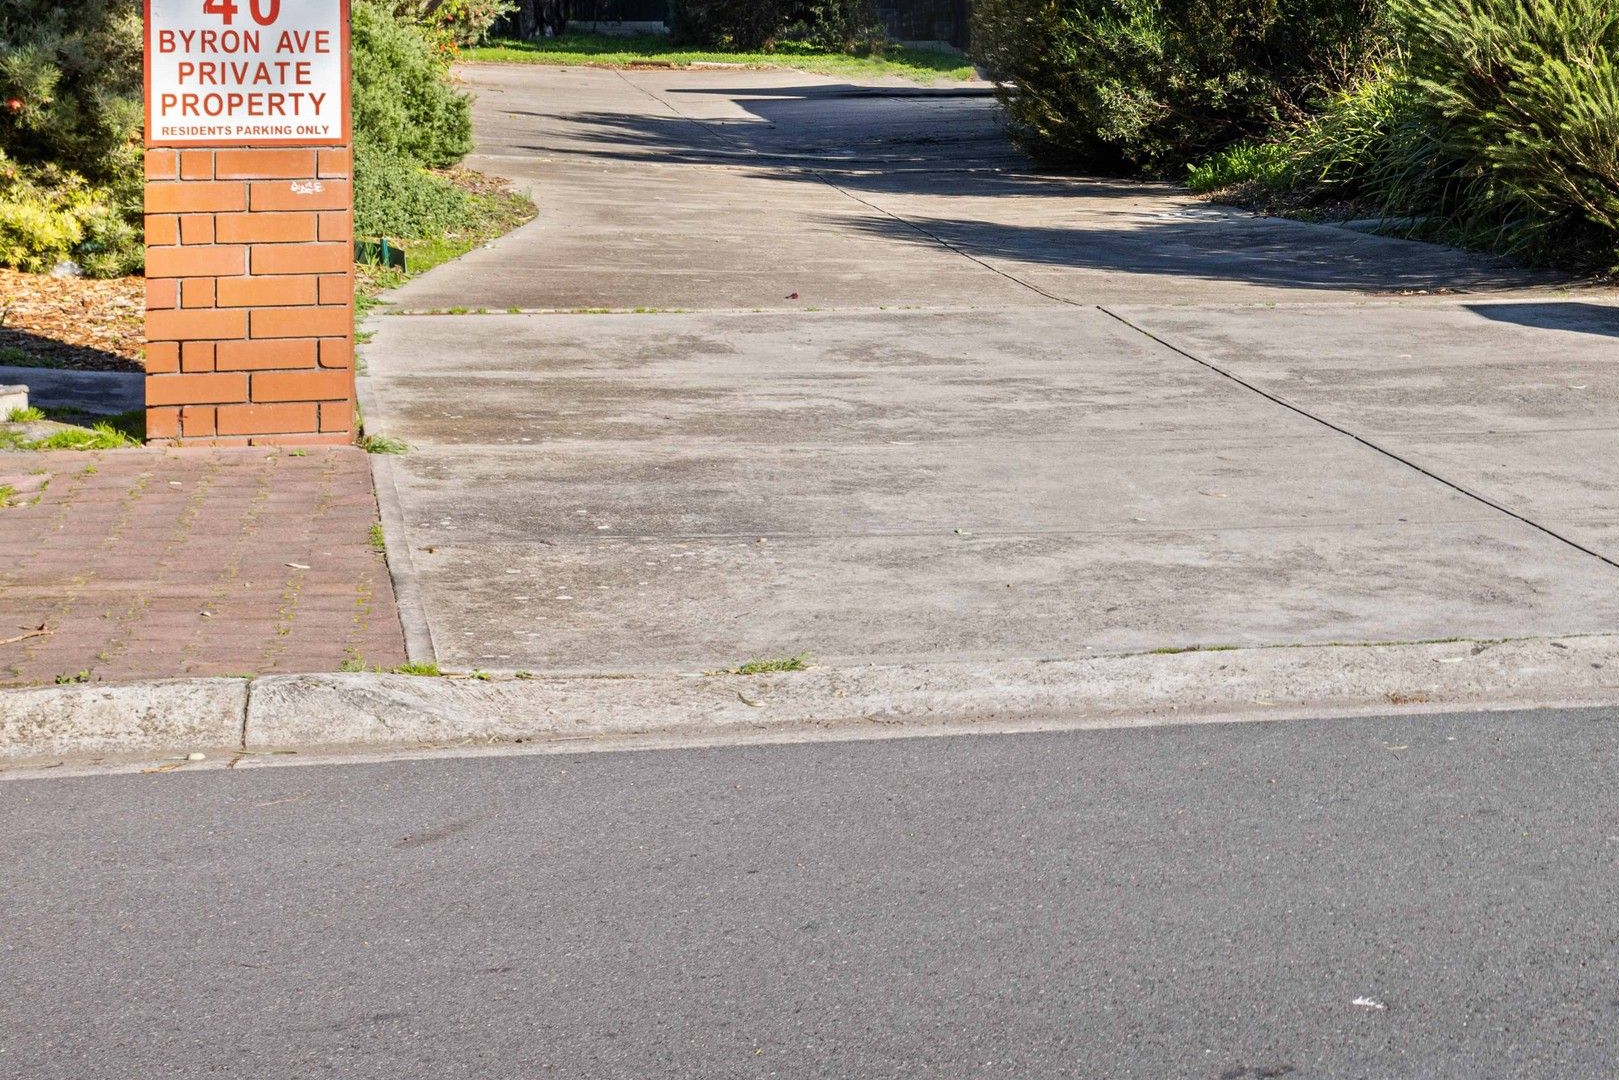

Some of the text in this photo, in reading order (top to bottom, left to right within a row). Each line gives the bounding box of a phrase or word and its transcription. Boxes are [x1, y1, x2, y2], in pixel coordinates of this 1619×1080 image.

[159, 30, 330, 54] BYRON AVE
[178, 61, 312, 85] PRIVATE
[161, 92, 326, 117] PROPERTY
[162, 125, 330, 136] RESIDENTS PARKING ONLY
